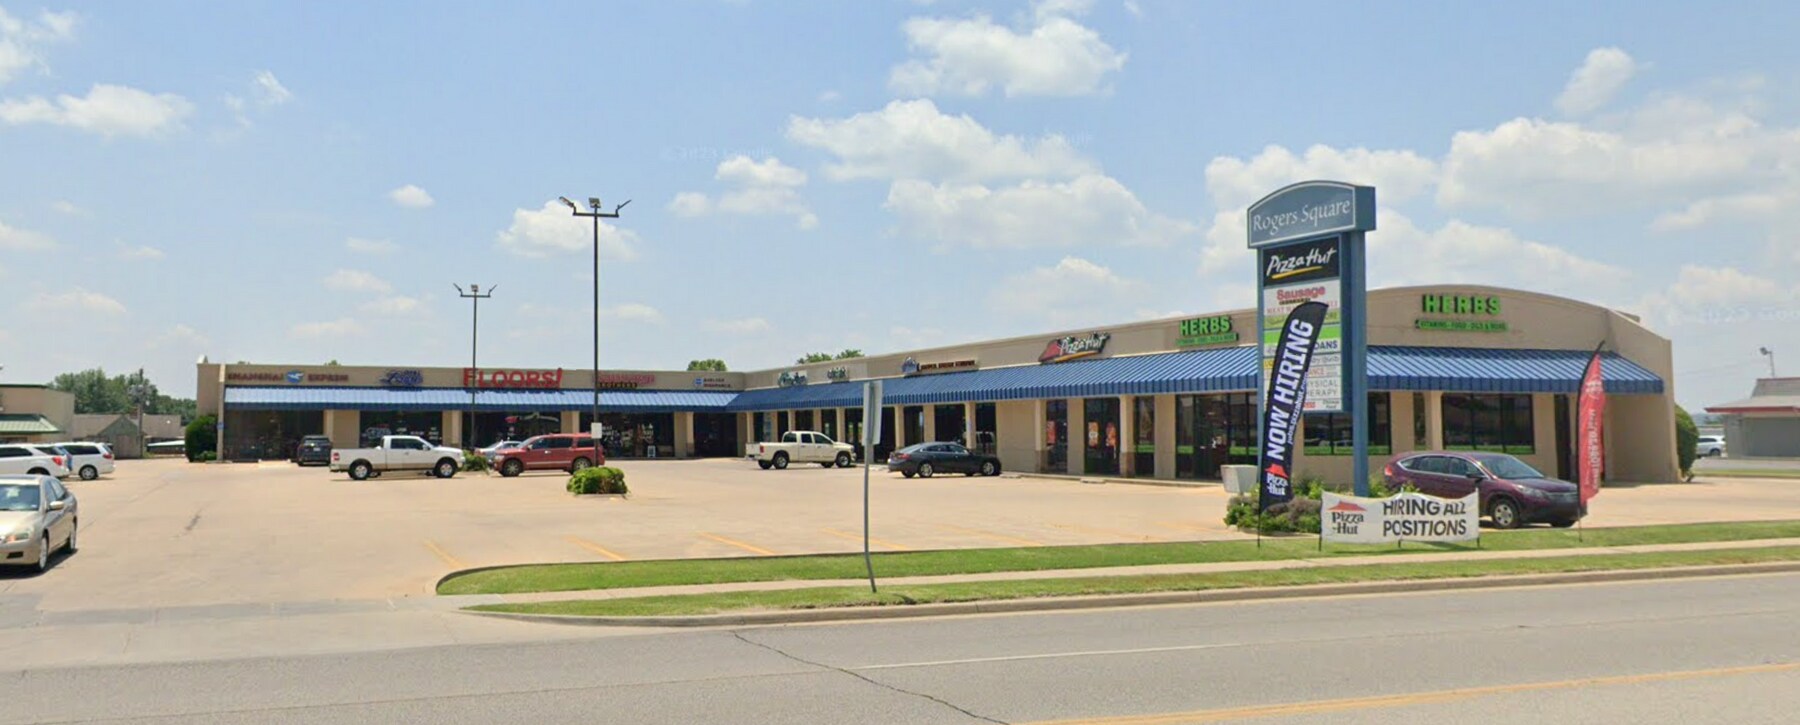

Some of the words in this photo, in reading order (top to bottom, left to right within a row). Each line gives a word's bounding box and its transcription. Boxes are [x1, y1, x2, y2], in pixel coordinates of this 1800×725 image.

[1252, 210, 1298, 236] Rogers
[1301, 199, 1351, 227] Square
[1266, 254, 1304, 276] Pizza
[1305, 247, 1337, 267] Hut
[1276, 286, 1326, 300] Sausage
[1422, 293, 1501, 315] HERBS
[1180, 314, 1231, 336] HERBS
[1314, 340, 1338, 351] OANS
[1273, 318, 1314, 404] HIRING
[463, 367, 562, 389] FLOORS!
[1266, 405, 1290, 461] NOW
[1331, 511, 1365, 524] Pizza
[1383, 499, 1440, 516] HIRING
[1443, 501, 1466, 515] ALL
[1333, 523, 1359, 535] Hut
[1383, 519, 1467, 537] POSITIONS
